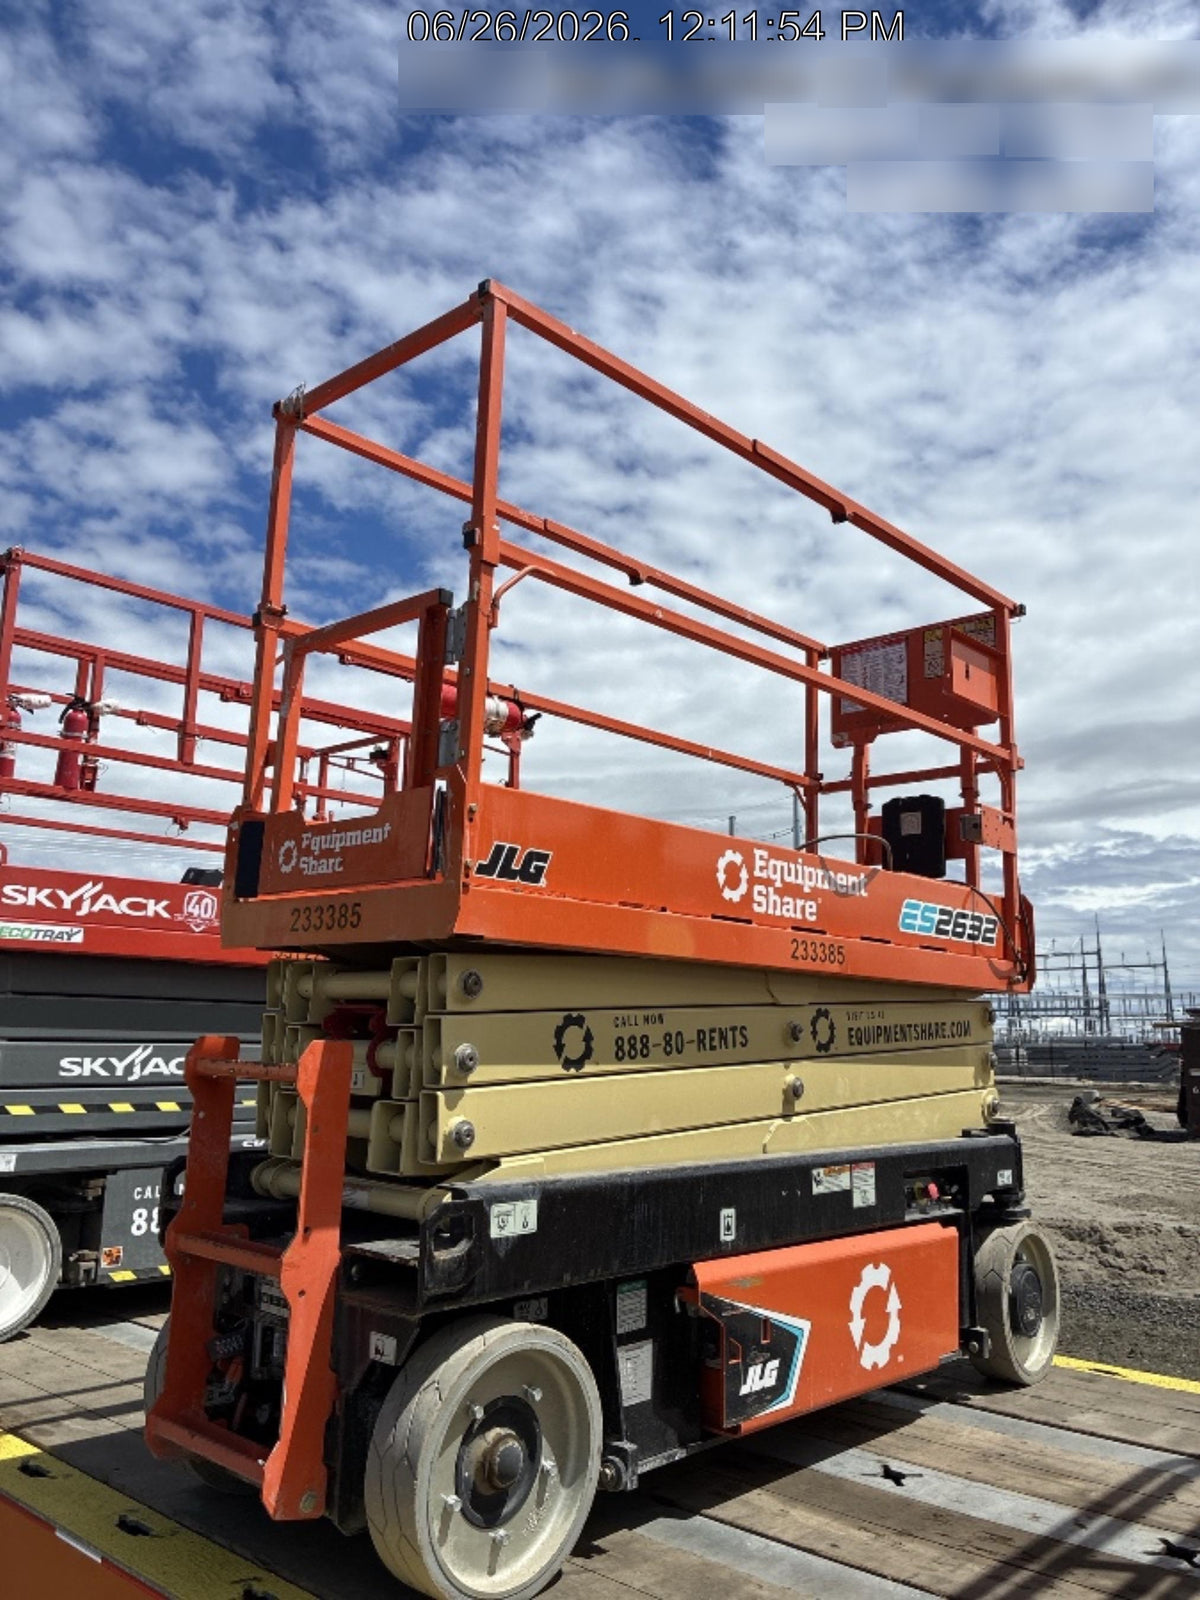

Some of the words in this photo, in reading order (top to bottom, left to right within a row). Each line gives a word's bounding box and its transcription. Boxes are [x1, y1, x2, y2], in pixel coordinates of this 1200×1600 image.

[473, 841, 553, 887] JLG
[753, 848, 868, 897] Equipment
[2, 881, 171, 919] SKYJACK
[187, 896, 213, 919] 40
[290, 902, 362, 932] 233385
[753, 884, 818, 922] Share
[899, 898, 999, 947] ES2632
[791, 938, 846, 965] 233385
[614, 1015, 639, 1028] CALL
[847, 1020, 972, 1046] EQUIPMENTSHARE.COM
[614, 1025, 749, 1062] 888-80-RENTS
[59, 1044, 185, 1081] SKYJAC
[134, 1185, 161, 1200] CAL
[739, 1358, 780, 1396] JLG
